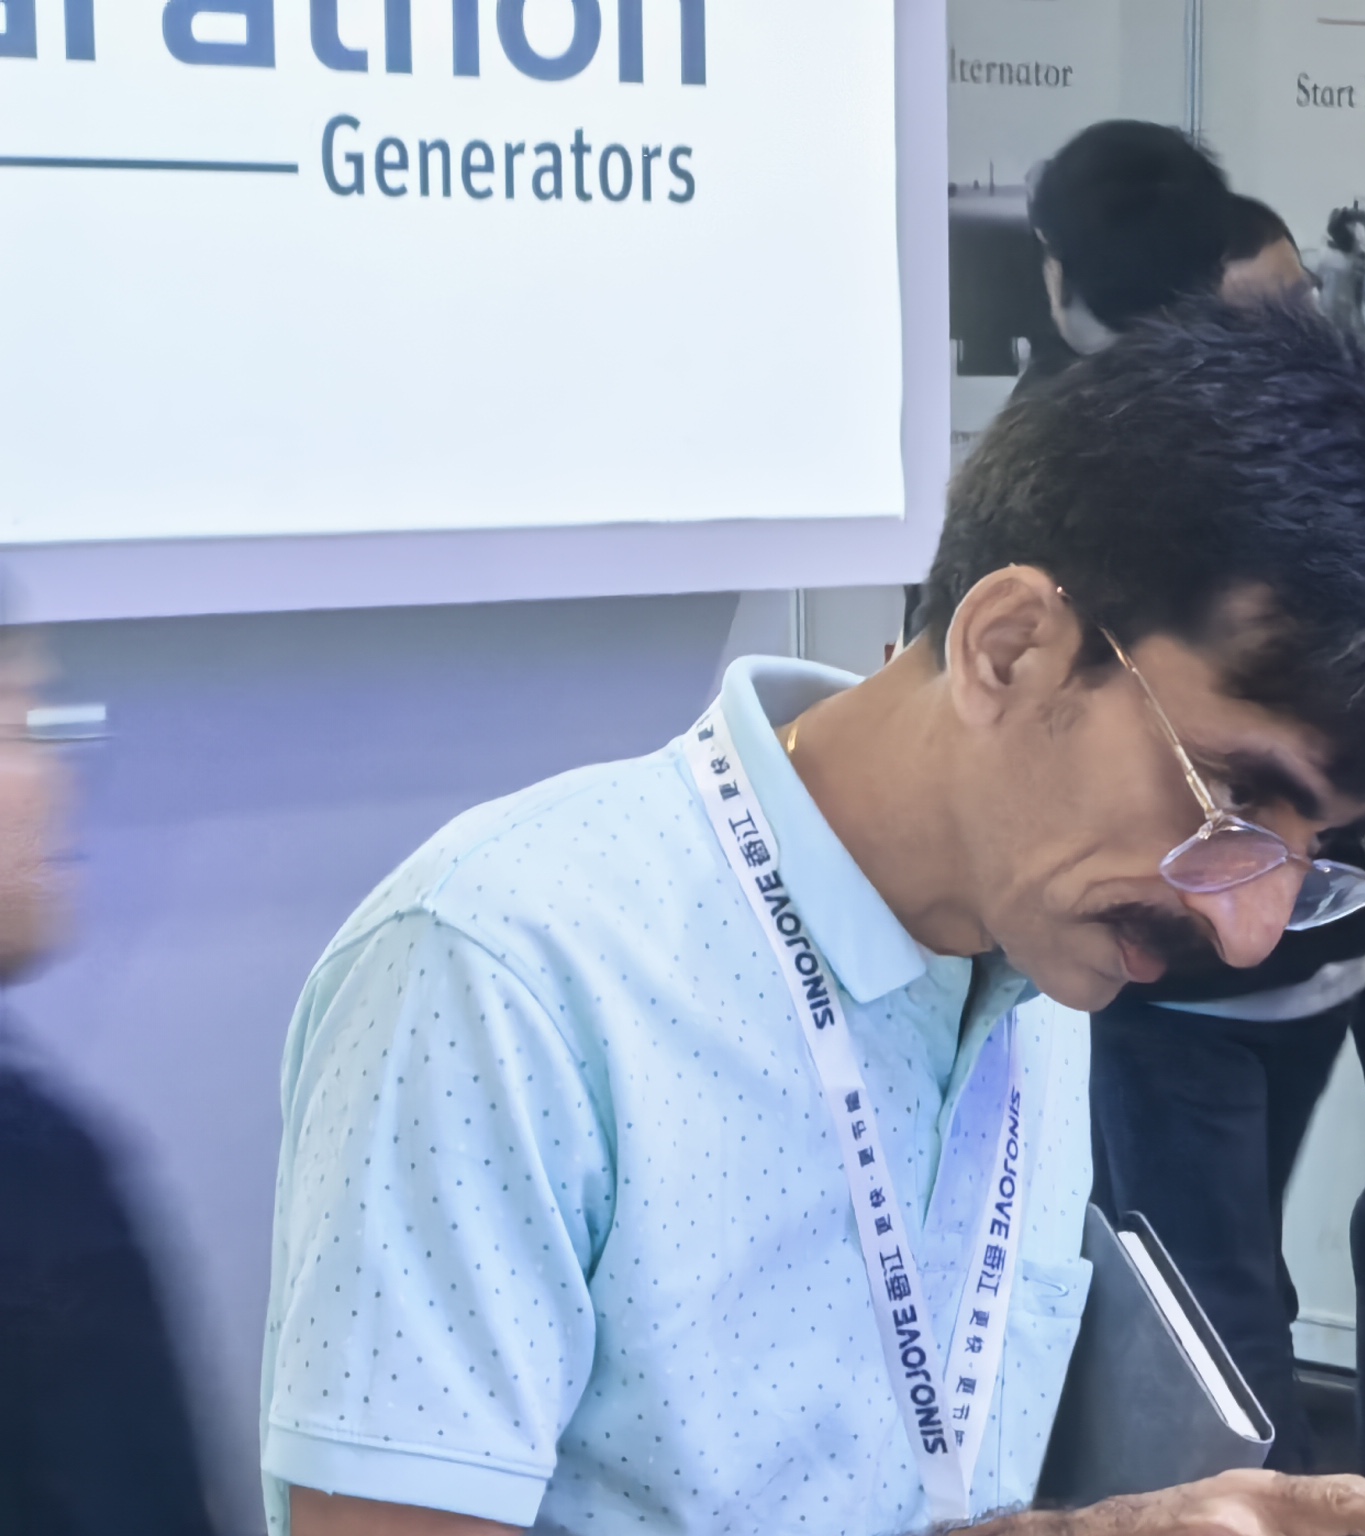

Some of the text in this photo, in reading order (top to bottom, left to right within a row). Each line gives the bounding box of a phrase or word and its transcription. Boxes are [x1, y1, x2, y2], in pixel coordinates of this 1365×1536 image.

[320, 114, 697, 203] Generators
[1296, 73, 1355, 109] Start
[756, 868, 836, 1031] SINOJOVE
[990, 1086, 1022, 1242] SINOJOVE
[892, 1304, 949, 1457] SINOJOVE
